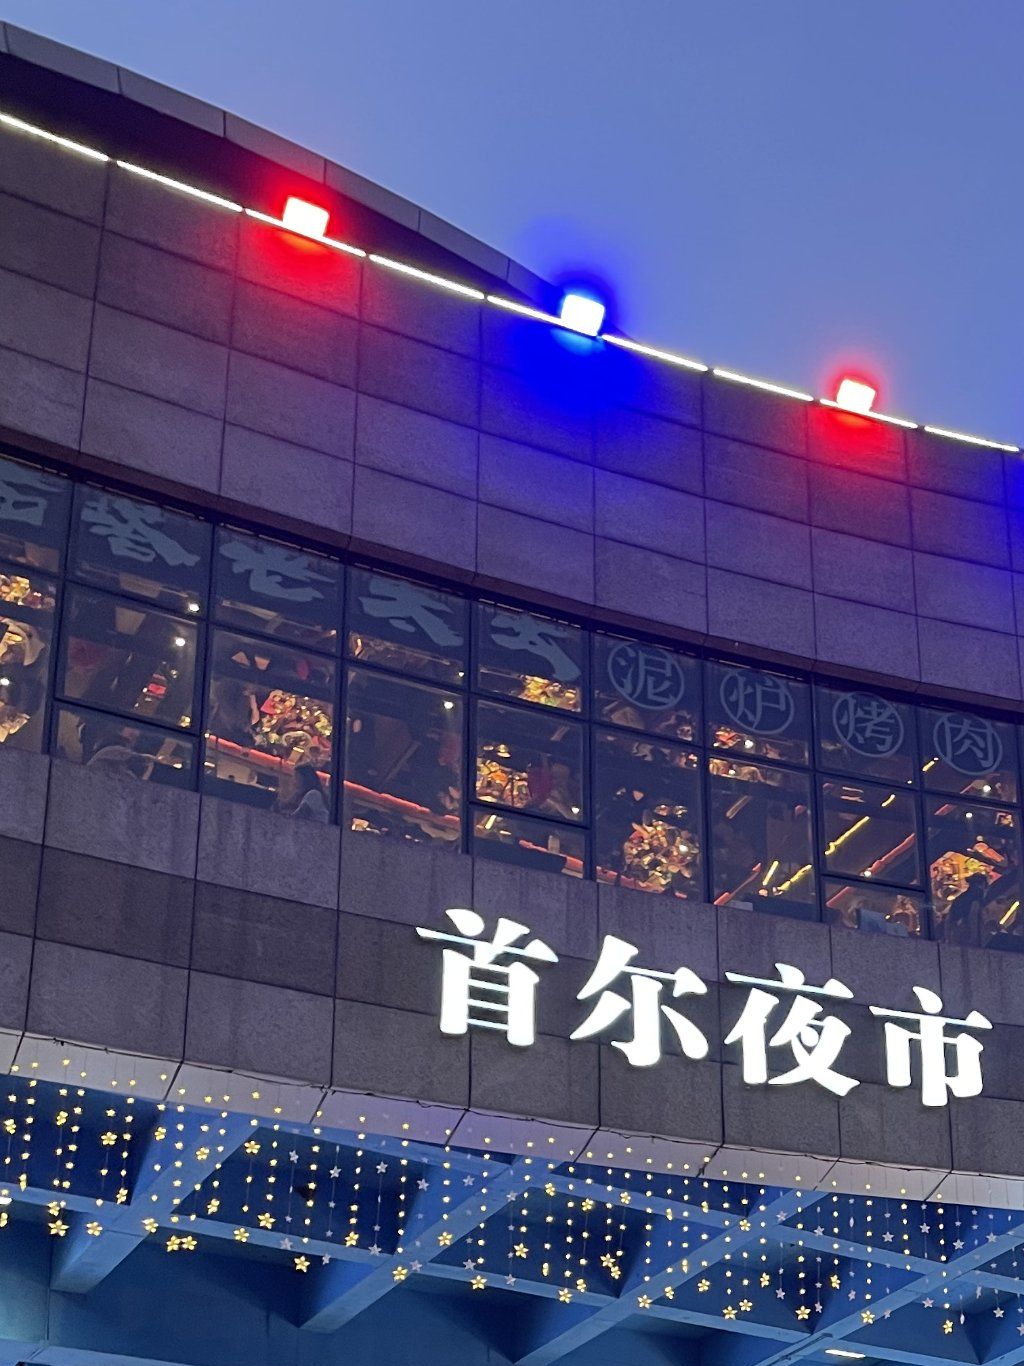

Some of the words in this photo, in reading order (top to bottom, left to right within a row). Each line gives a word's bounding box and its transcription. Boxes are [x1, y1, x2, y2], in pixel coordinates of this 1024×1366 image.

[612, 643, 998, 770] 泥炉烤肉
[415, 907, 994, 1108] 首尔夜市
